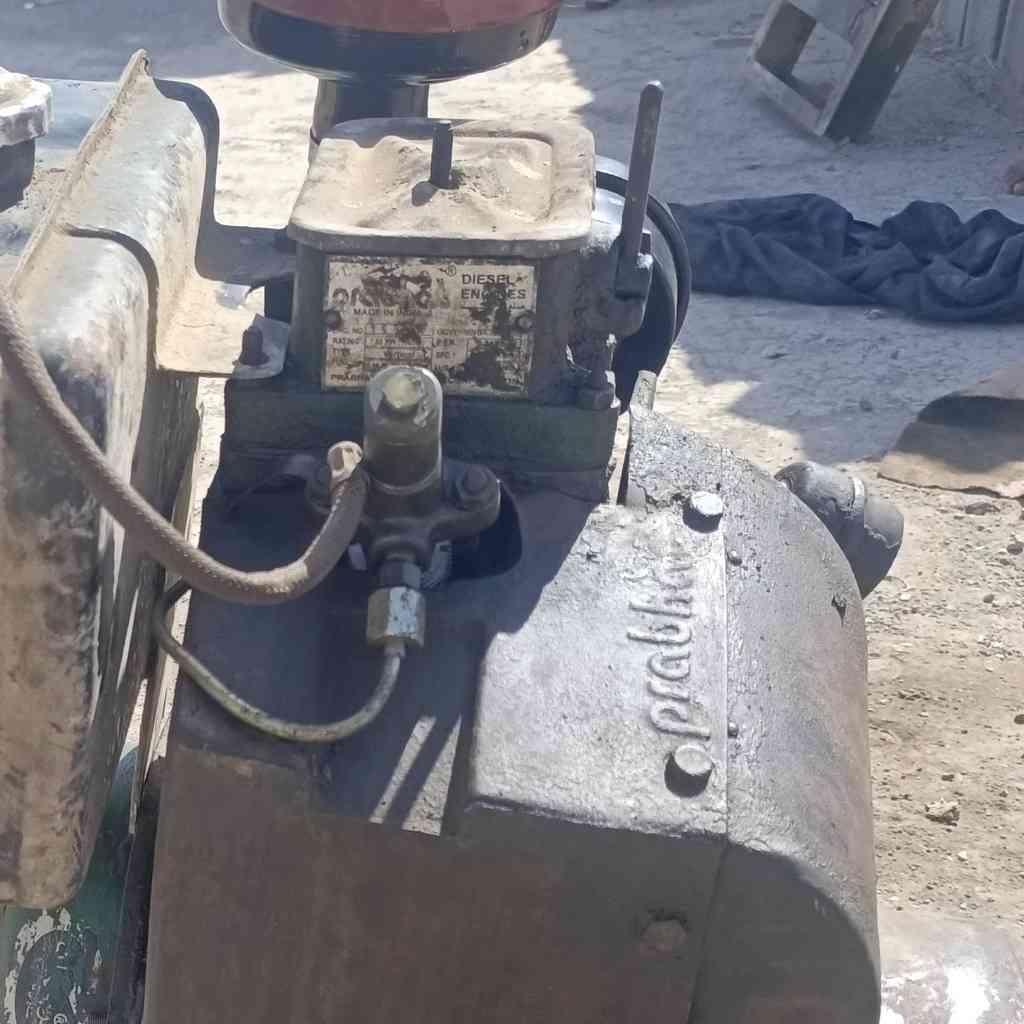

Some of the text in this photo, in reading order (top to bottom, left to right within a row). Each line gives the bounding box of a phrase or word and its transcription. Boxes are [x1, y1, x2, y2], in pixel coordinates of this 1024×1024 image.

[462, 273, 514, 286] DIESEL
[461, 288, 526, 300] ENES
[627, 550, 711, 741] prabha
